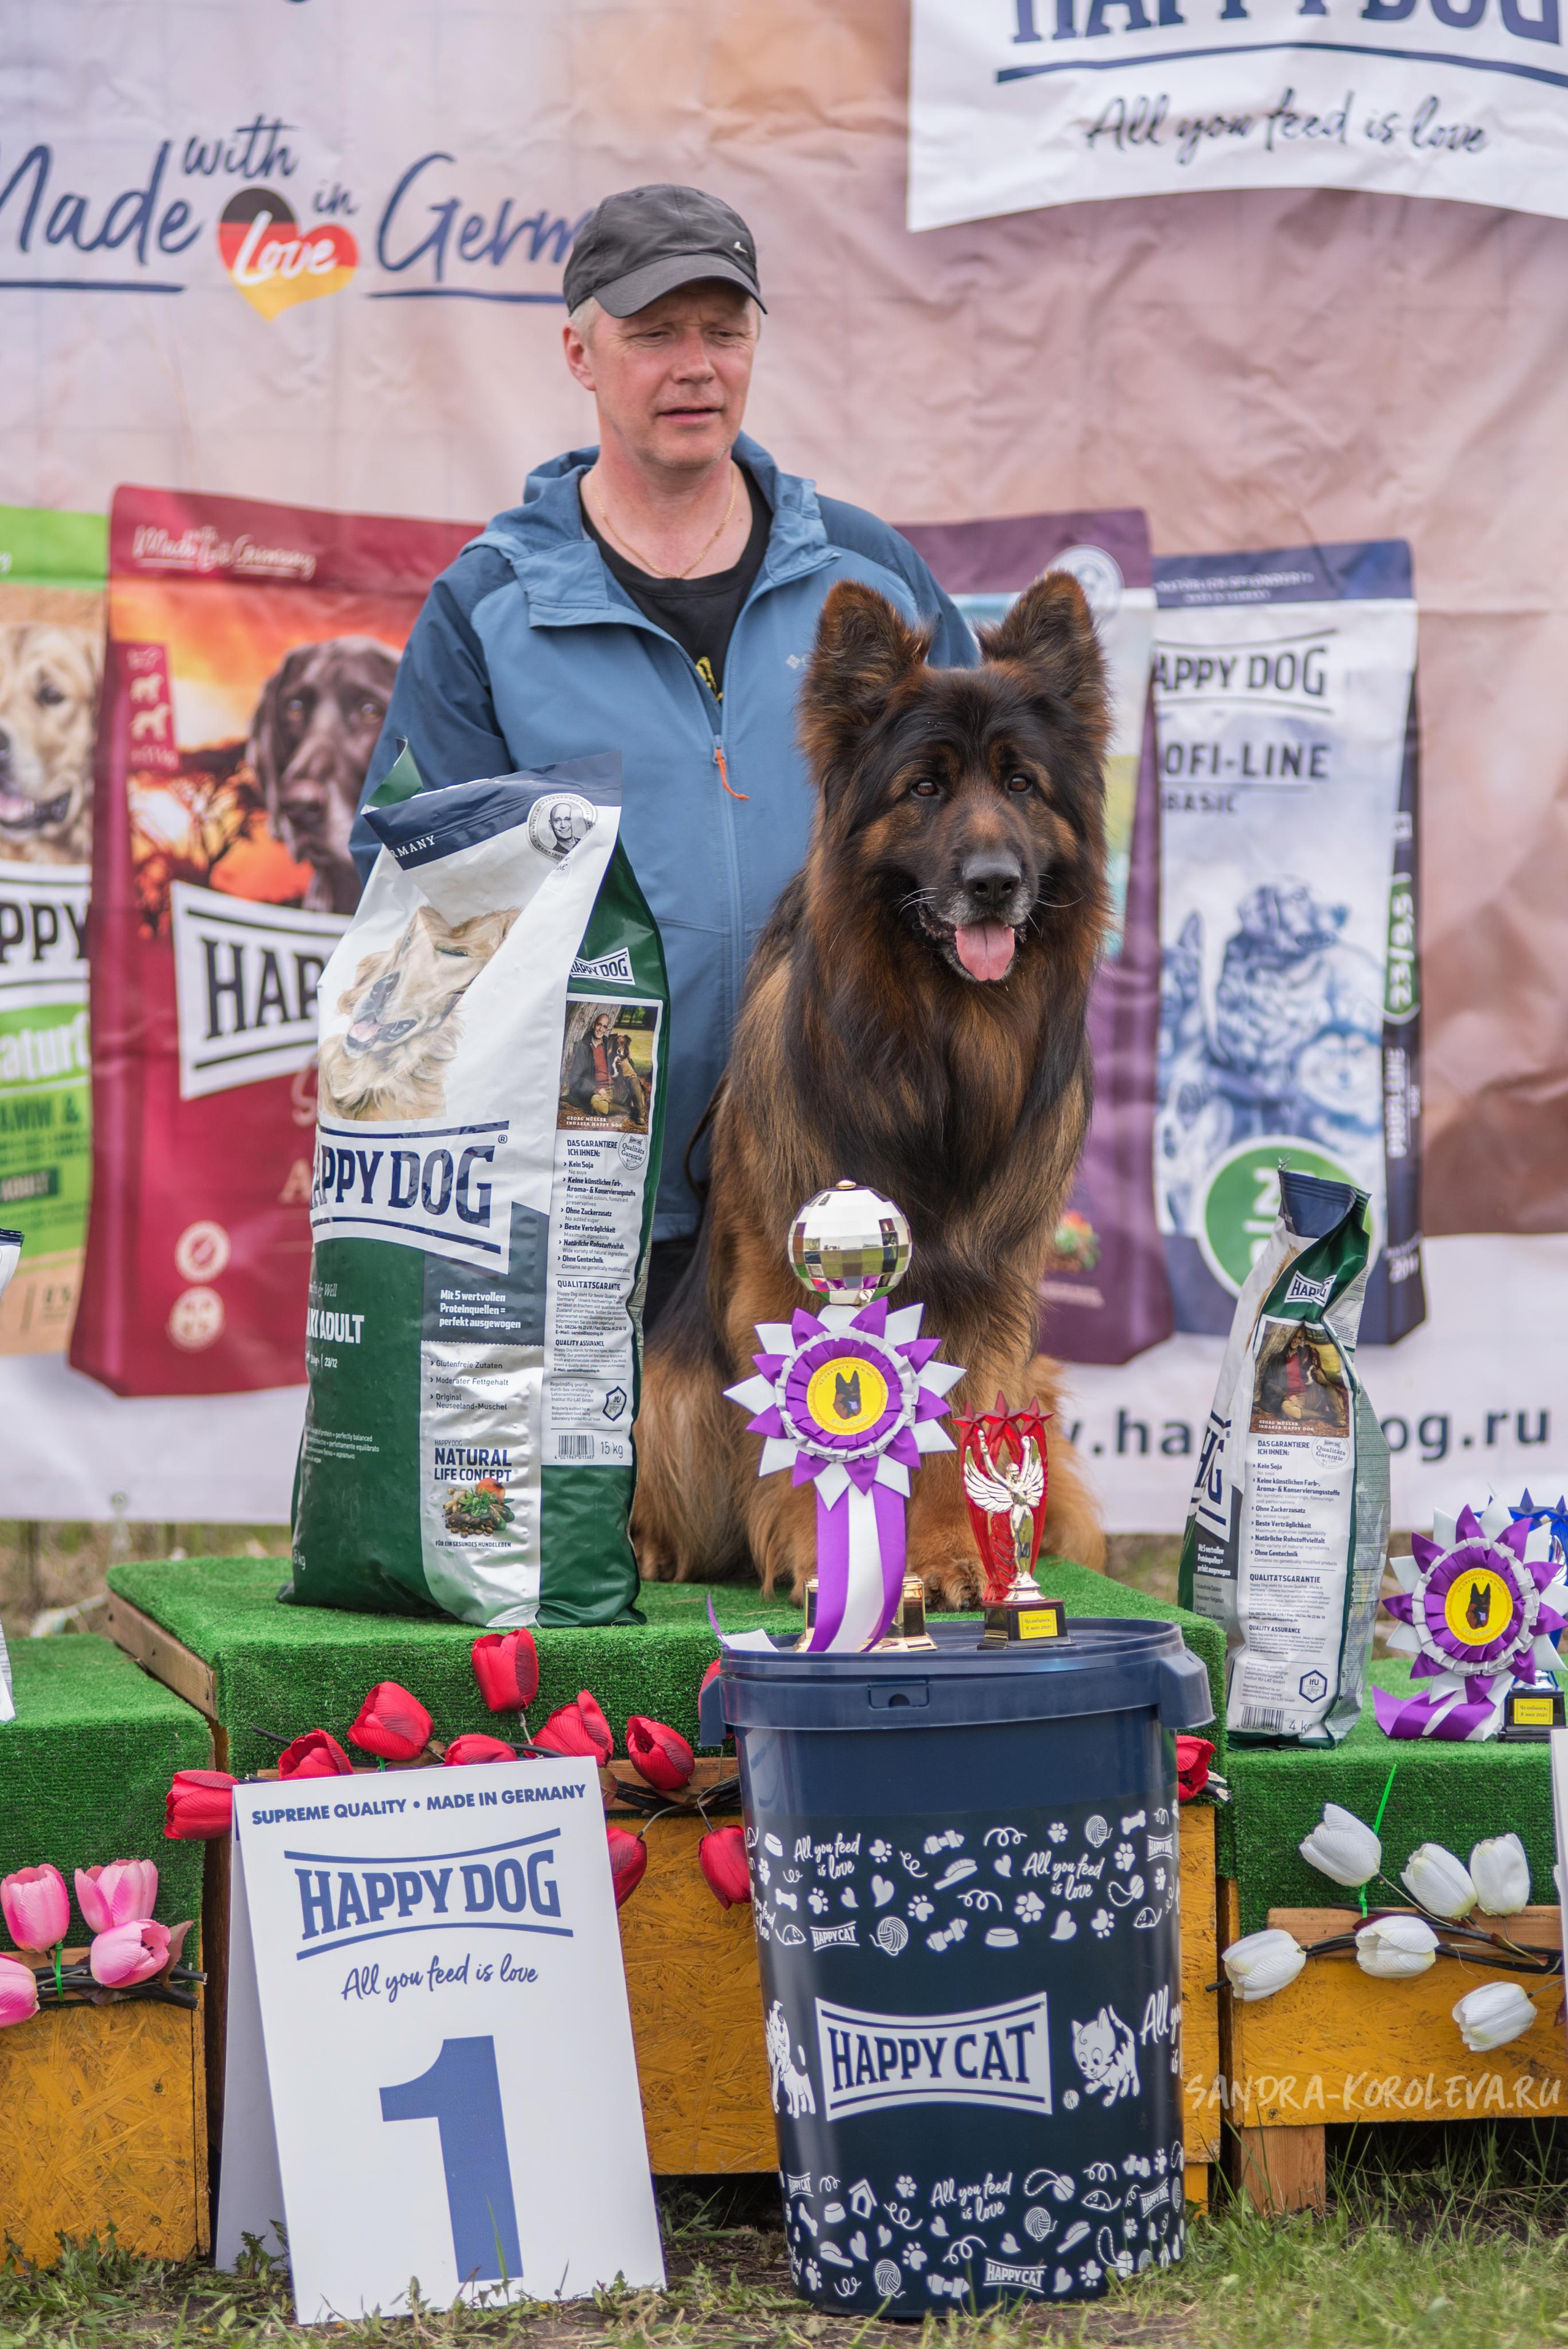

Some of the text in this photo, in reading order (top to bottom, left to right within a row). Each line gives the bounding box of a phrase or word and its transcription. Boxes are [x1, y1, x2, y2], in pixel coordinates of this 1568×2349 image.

[1085, 88, 1489, 164] All you feed is love
[184, 115, 301, 180] with
[312, 180, 358, 216] in
[377, 152, 581, 282] Germ
[233, 210, 341, 285] Love
[1246, 645, 1327, 697] DOG
[599, 957, 628, 977] DOG
[200, 935, 325, 1042] HAP
[581, 1140, 617, 1149] GARANTIERE
[622, 1143, 644, 1155] Qualitäts
[621, 1149, 643, 1161] Garantie
[388, 1144, 496, 1228] DOG
[584, 1178, 611, 1186] künstlichen
[581, 1208, 612, 1217] Zuckerzusatz
[582, 1224, 616, 1233] Verträglichkeit
[440, 1289, 506, 1302] Mit 5 wertvollen
[557, 1280, 621, 1291] QUALITÄTSGARANTIE
[440, 1303, 499, 1315] Proteinquellen
[320, 1310, 365, 1344] ADULT
[439, 1316, 521, 1330] perfekt ausgewogen
[324, 1357, 338, 1368] 23/12
[436, 1360, 473, 1368] Glutenfreie
[472, 1378, 508, 1386] Fettgehalt
[435, 1393, 462, 1402] Original
[436, 1402, 508, 1410] Neuseeland-Muschel
[434, 1448, 512, 1467] NATURAL
[600, 1441, 624, 1459] 15 kg
[1316, 1445, 1346, 1456] Qualitäts
[1316, 1451, 1344, 1461] Garantie
[434, 1467, 512, 1481] LIFE CONCEPT
[1283, 1486, 1340, 1496] Konservierungsstoffe
[1283, 1535, 1325, 1544] Rohstoffvielfalt
[1250, 1573, 1321, 1583] QUALITÄTSGARANTIE
[252, 1784, 586, 1825] SUPREME QUALITY MADE IN GERMANY
[794, 1832, 861, 1863] All you feed
[817, 1854, 856, 1880] is love
[1022, 1850, 1106, 1881] All you feed
[295, 1848, 562, 1941] HAPPY DOG
[1050, 1874, 1093, 1901] is love
[812, 1926, 856, 1947] HAPPY CAT
[341, 1953, 539, 2003] All you feed is love
[1139, 1984, 1169, 2046] All
[827, 2021, 1036, 2092] HAPPY CAT
[379, 2034, 524, 2284] 1
[930, 2171, 1013, 2208] All you feed
[1141, 2182, 1169, 2212] HAPPY DOG
[961, 2196, 1005, 2222] is love
[985, 2264, 1045, 2288] HAPPY CAT
